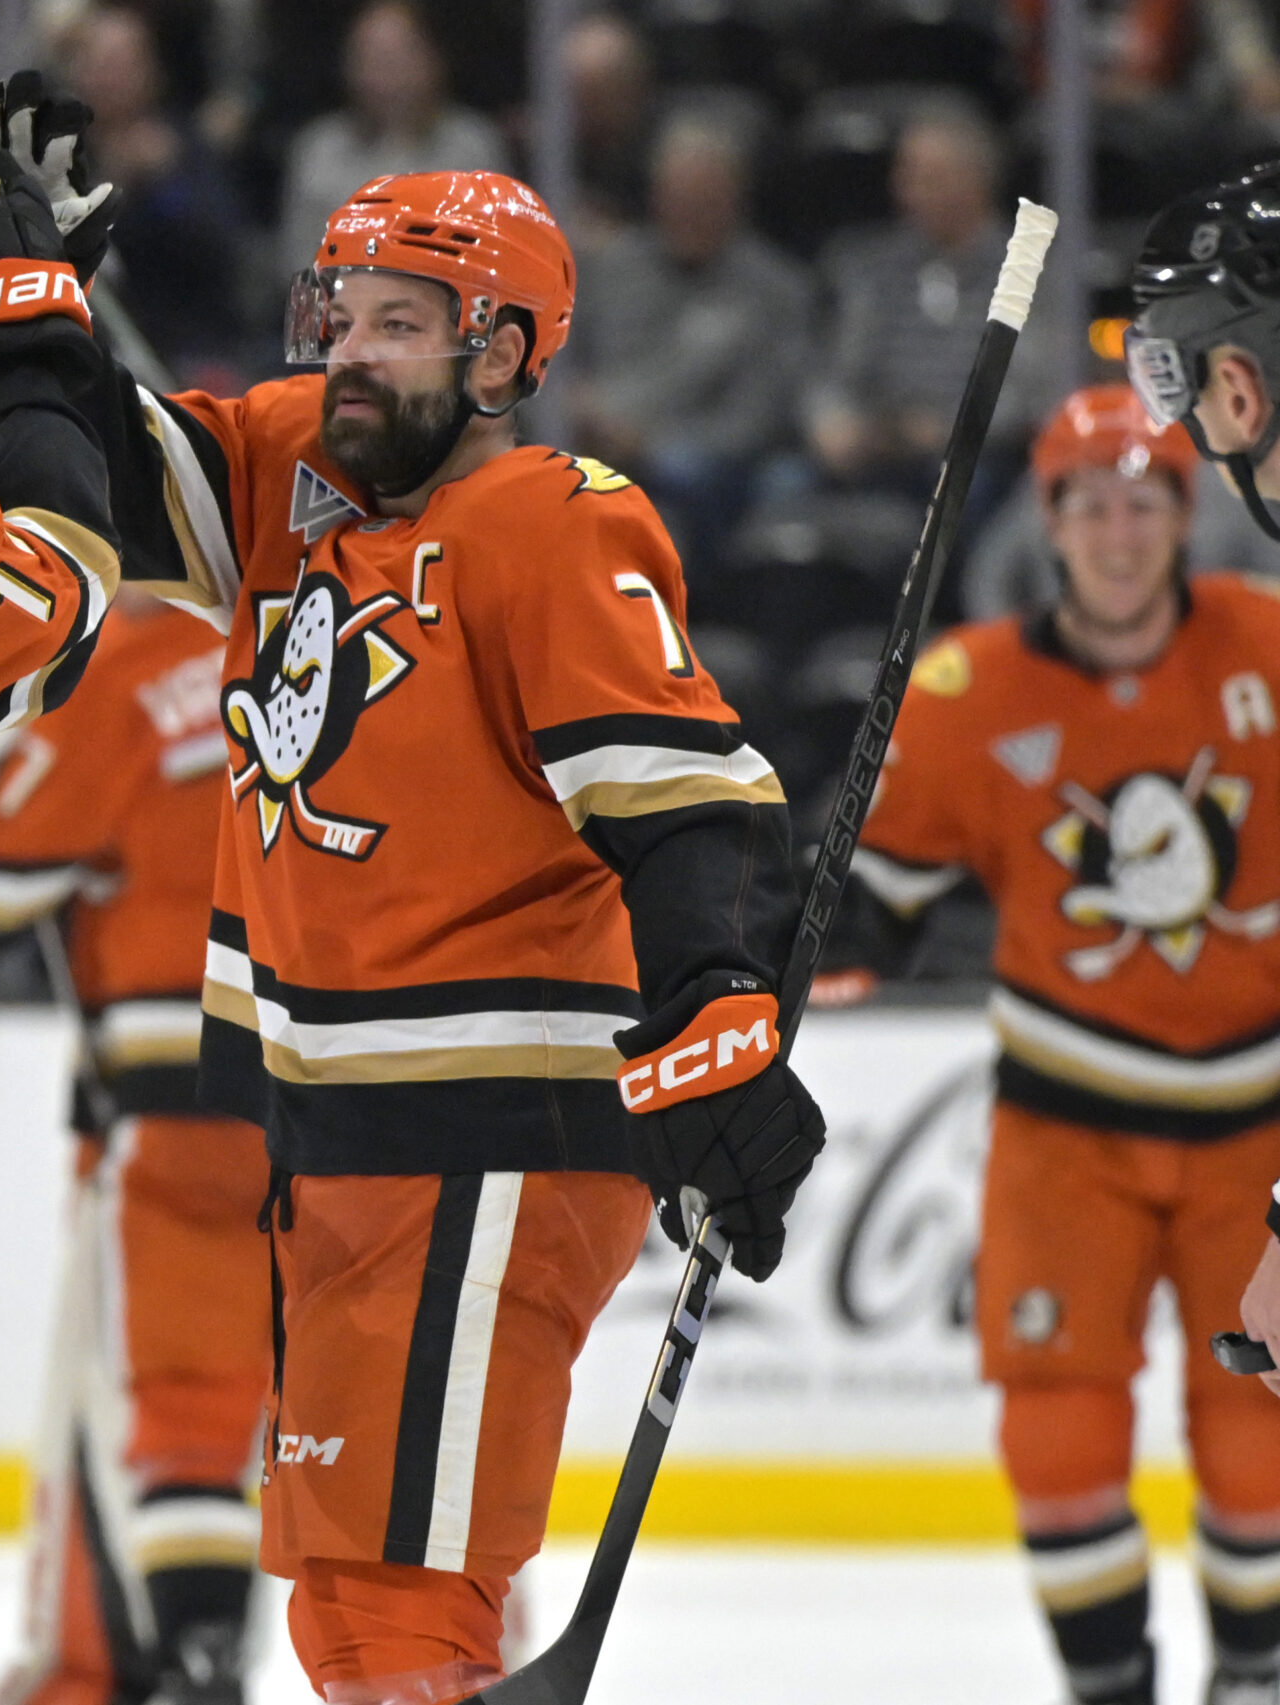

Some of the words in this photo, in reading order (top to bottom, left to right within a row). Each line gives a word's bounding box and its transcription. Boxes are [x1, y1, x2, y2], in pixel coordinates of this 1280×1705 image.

[335, 216, 386, 230] CCM
[411, 542, 444, 626] C
[613, 572, 695, 679] 7
[1220, 671, 1273, 740] A
[800, 695, 895, 965] JETSPEED
[620, 1018, 770, 1108] CCM
